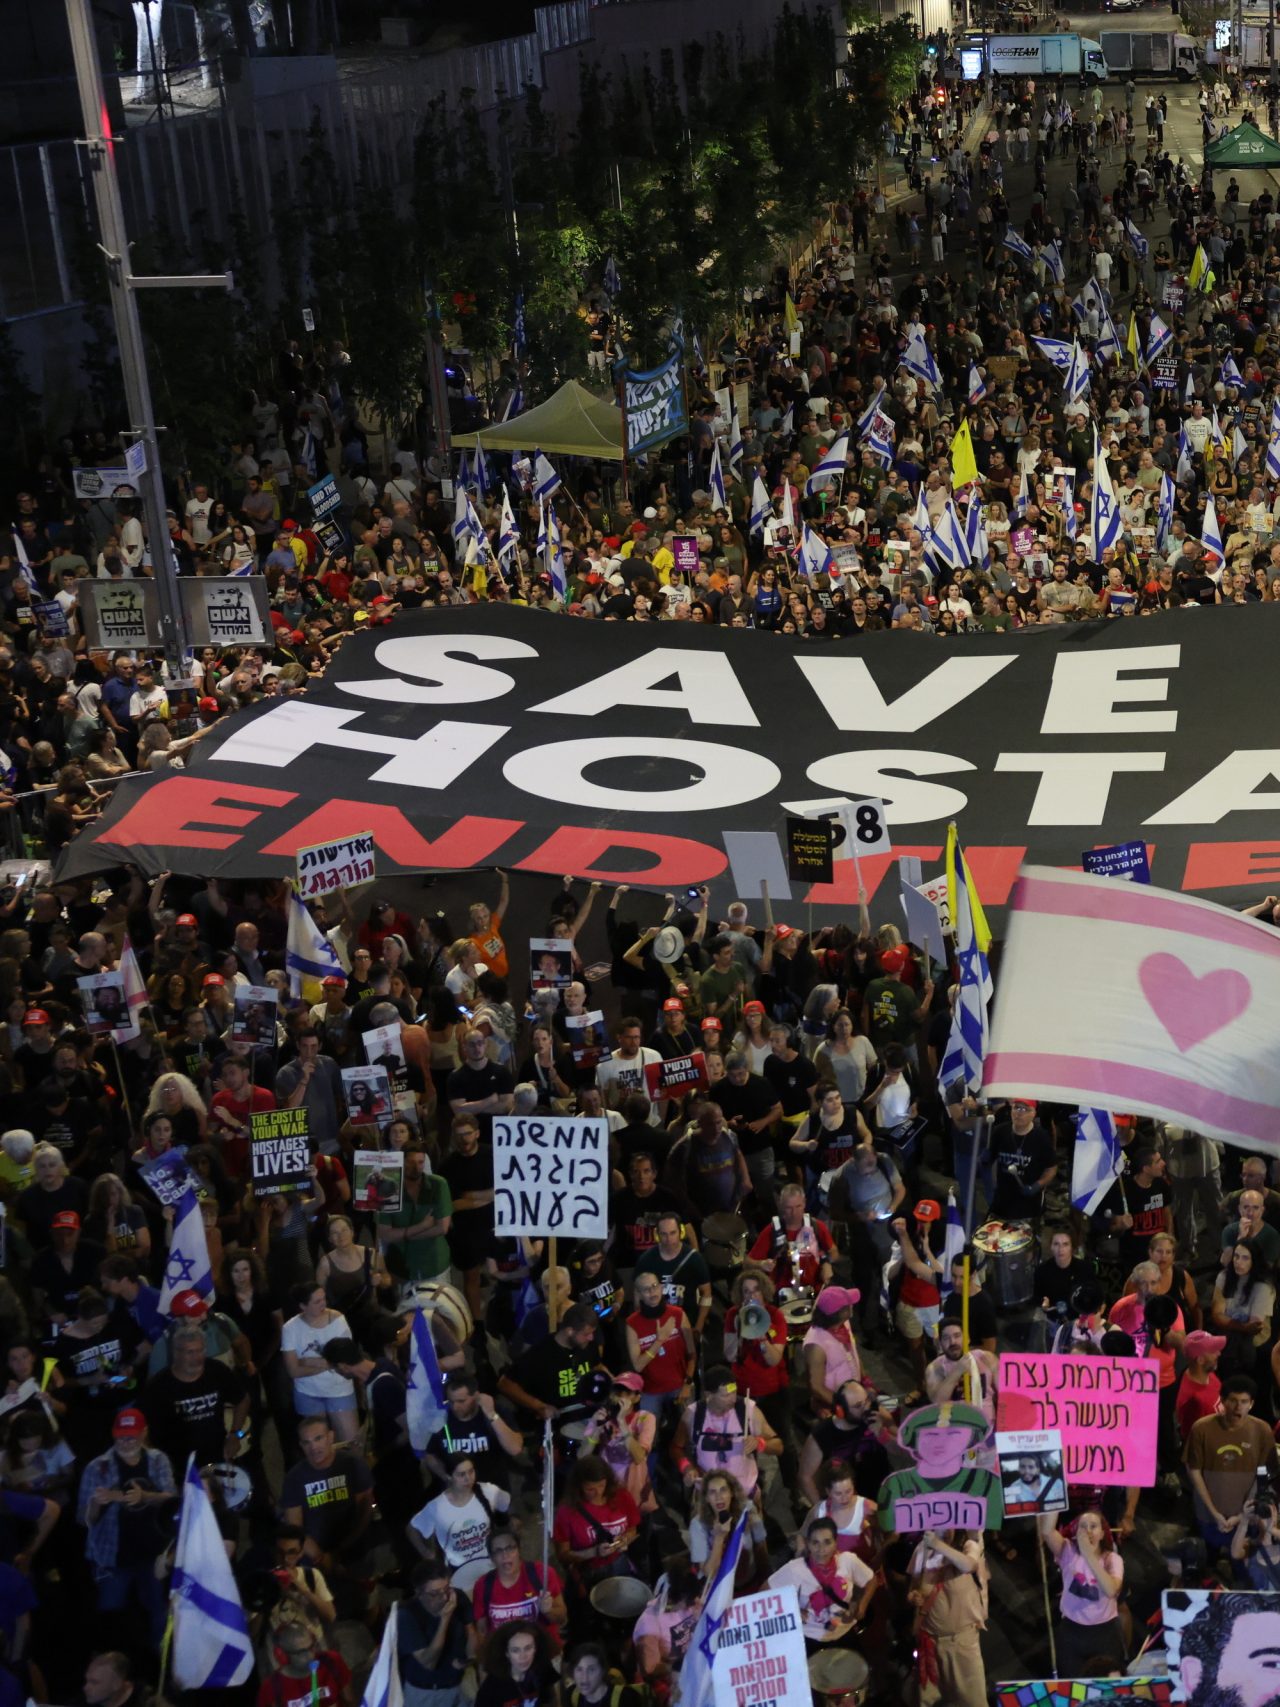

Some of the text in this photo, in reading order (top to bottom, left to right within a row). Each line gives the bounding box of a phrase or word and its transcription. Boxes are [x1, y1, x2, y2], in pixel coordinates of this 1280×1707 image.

[992, 47, 1039, 58] LOGISTEAM
[1154, 379, 1177, 388] ישראל
[1157, 368, 1176, 377] נגד
[311, 481, 337, 505] END THE
[314, 492, 341, 516] BLOODSHED
[102, 609, 143, 624] אשם
[209, 608, 249, 621] אשם
[104, 626, 146, 637] במחדל
[211, 623, 252, 635] במחדל
[334, 634, 1181, 734] SAVE
[94, 776, 728, 887] END
[792, 830, 827, 842] ממשלת
[299, 836, 374, 871] האדישות
[792, 845, 827, 855] הסטרא
[797, 856, 824, 866] אחרא
[1088, 846, 1142, 864] אין ניצחון בלי
[1089, 857, 1144, 873] סגן הדר גולדין
[300, 858, 374, 897] הורגת!
[664, 1058, 692, 1074] עכשיו
[687, 1068, 700, 1080] זה
[250, 1109, 307, 1127] THE COST OF
[252, 1122, 309, 1140] YOUR WAR:
[495, 1120, 600, 1150] ממשלה
[253, 1149, 310, 1178] LIVES!
[501, 1154, 602, 1186] בוגדת
[154, 1178, 177, 1194] He
[494, 1188, 600, 1228] בעמה
[1003, 1358, 1158, 1395] במלחמת נצח
[1030, 1392, 1130, 1429] תעשה לך
[442, 1432, 489, 1453] חופשי
[1067, 1444, 1125, 1475] ממש
[895, 1501, 984, 1529] הופקר
[753, 1595, 784, 1618] ביבי
[756, 1613, 797, 1639] במושב
[743, 1640, 768, 1662] נגד
[729, 1656, 788, 1686] עסקאות
[735, 1677, 787, 1707] חטופים
